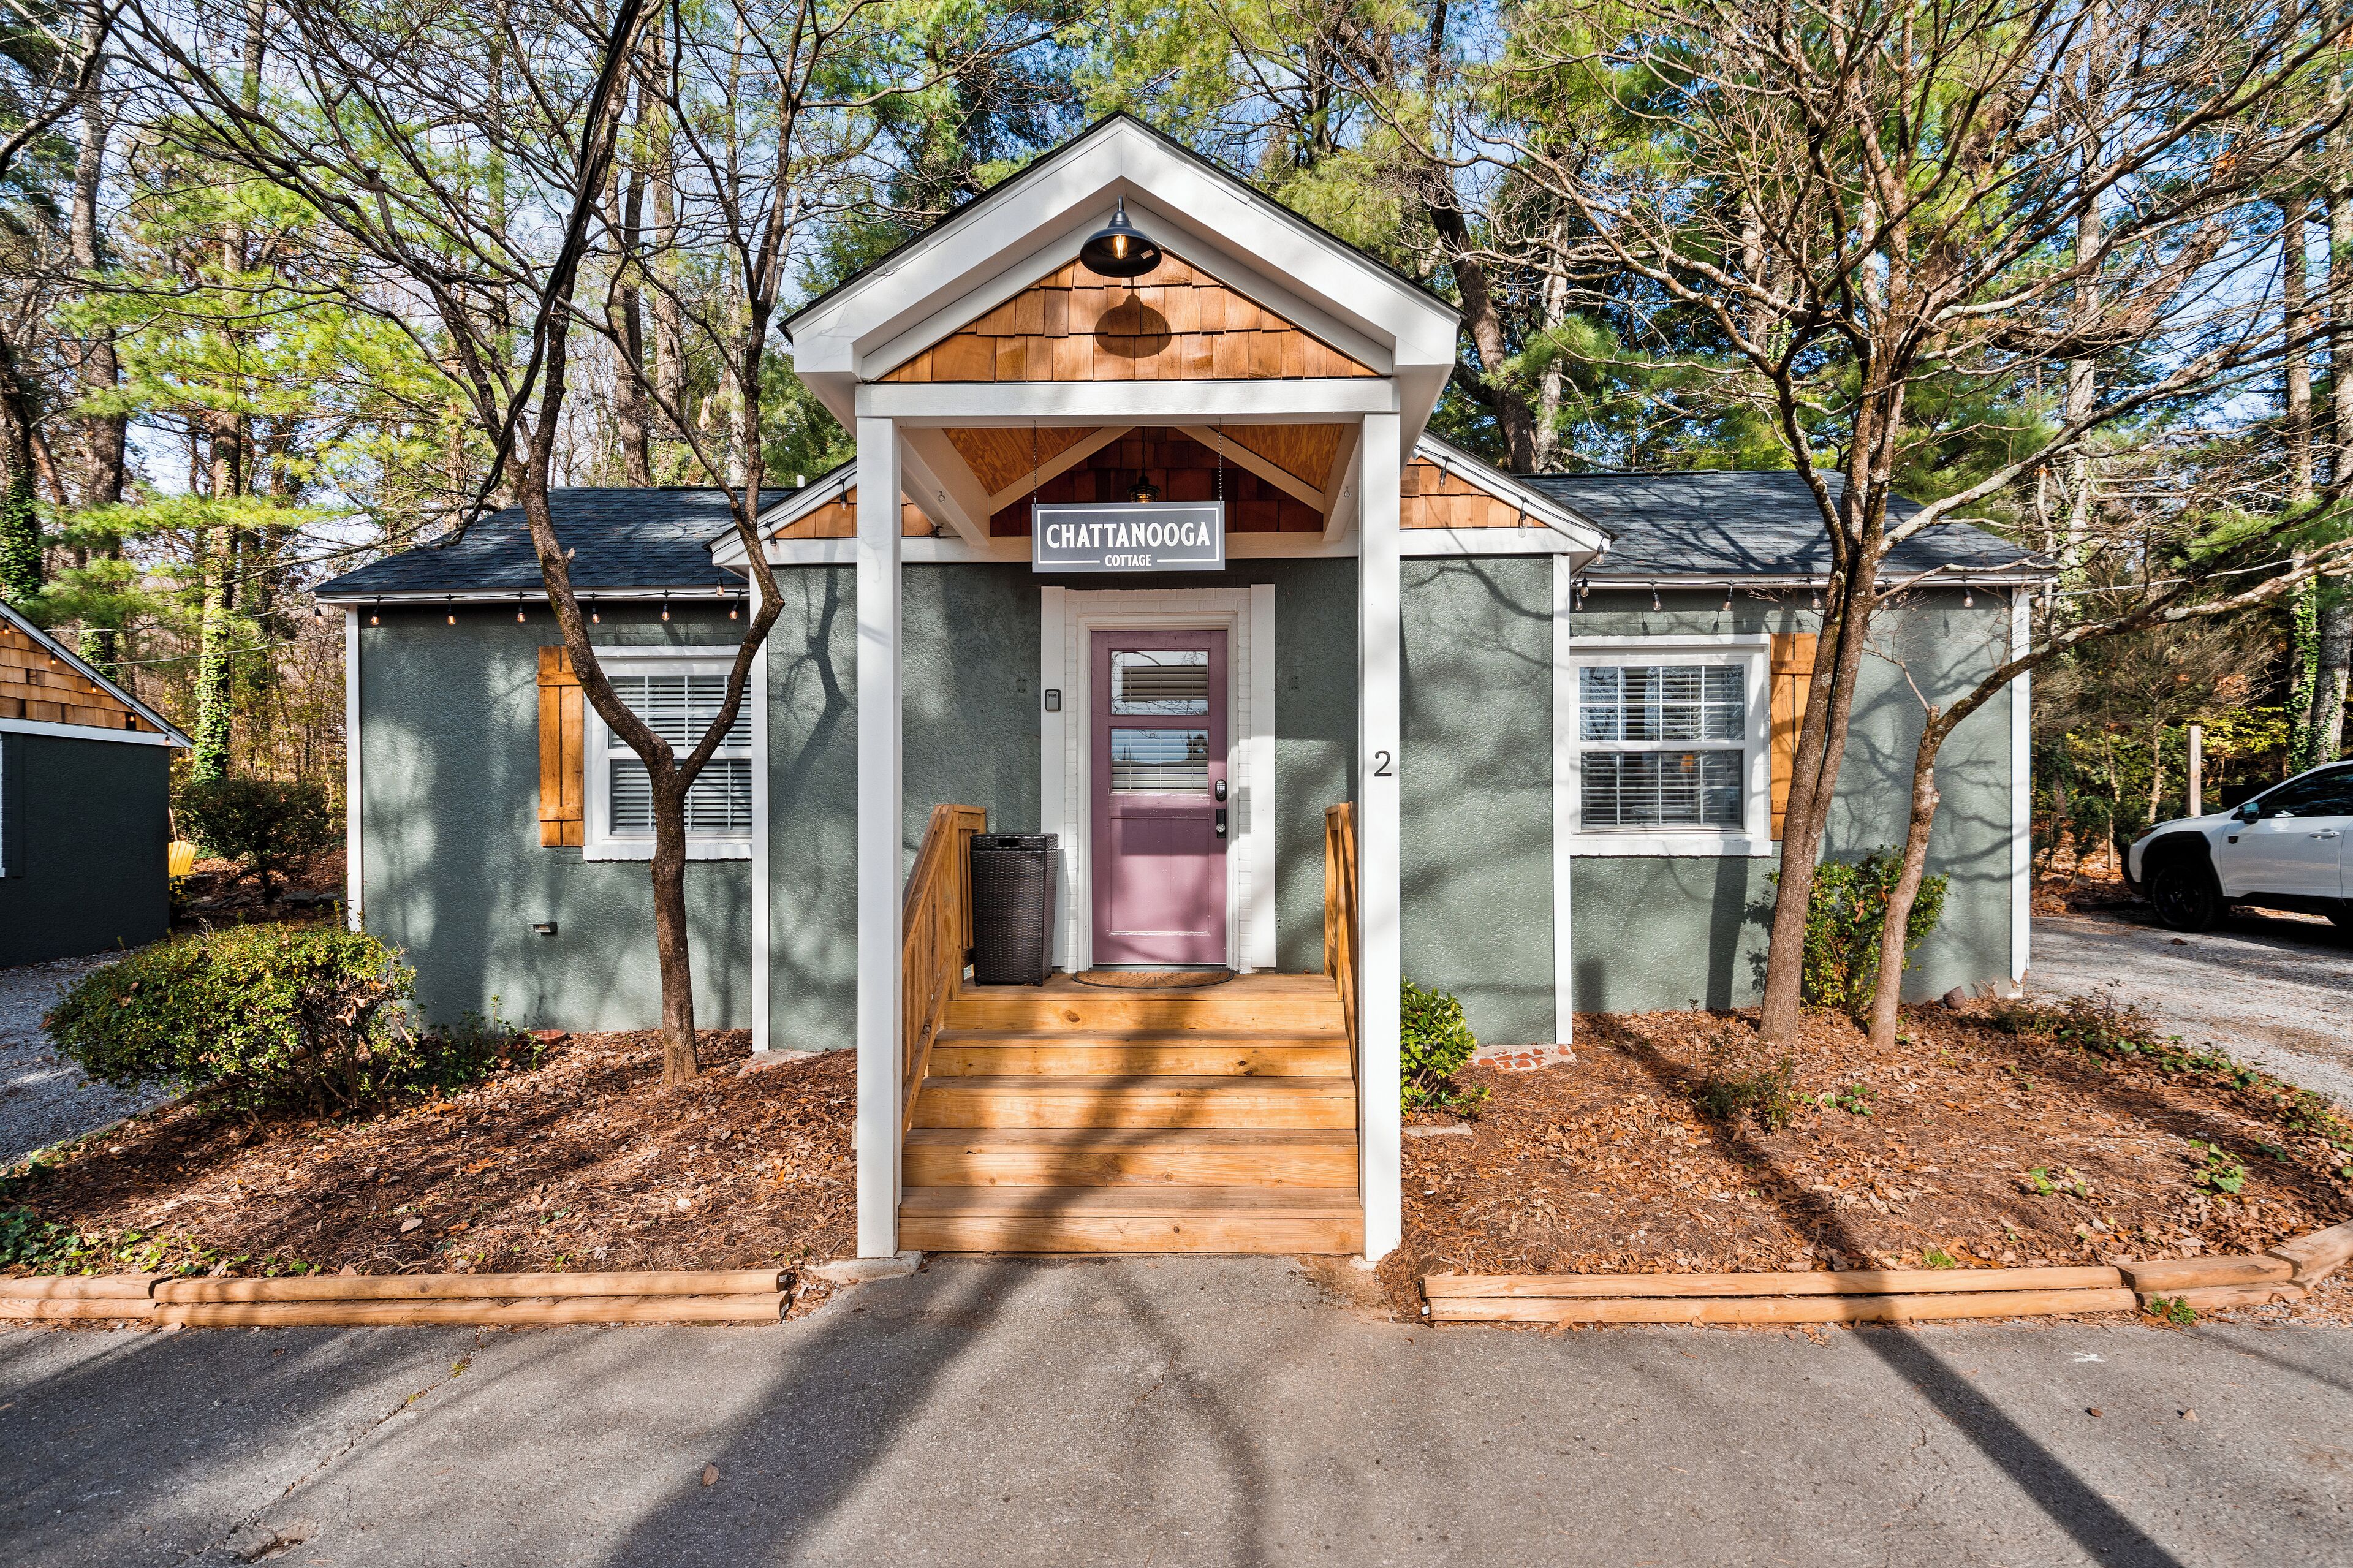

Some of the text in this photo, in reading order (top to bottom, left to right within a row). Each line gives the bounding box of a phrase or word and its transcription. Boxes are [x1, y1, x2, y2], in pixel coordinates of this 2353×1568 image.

[1046, 521, 1211, 548] CHATTANOOGA
[1105, 554, 1152, 567] COTTAGE
[1374, 750, 1392, 777] 2
